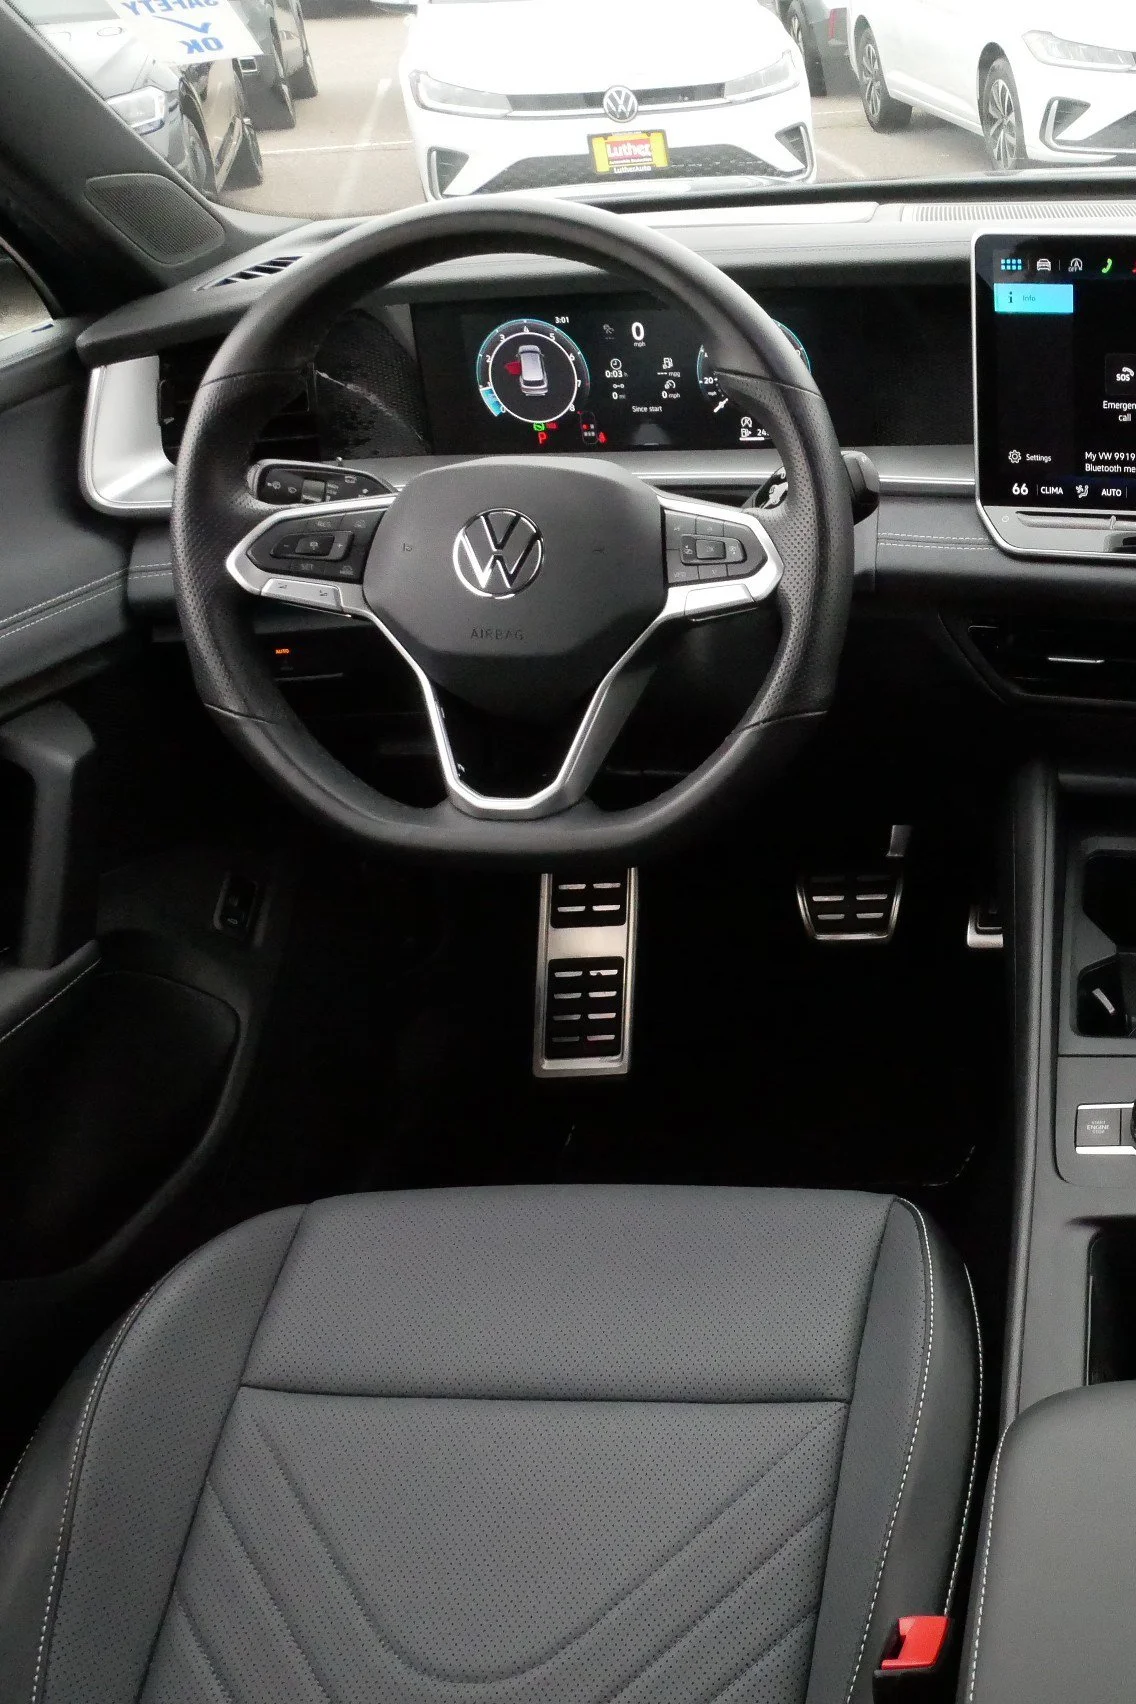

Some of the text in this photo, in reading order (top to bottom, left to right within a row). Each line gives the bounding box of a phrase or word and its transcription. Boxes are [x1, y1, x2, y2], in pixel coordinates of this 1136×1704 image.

[607, 142, 652, 158] Luther
[555, 316, 570, 324] 3:01
[631, 322, 645, 341] 0
[605, 370, 623, 378] 0:03
[703, 376, 714, 384] 20
[612, 391, 619, 400] 0
[661, 390, 668, 399] 0
[632, 405, 663, 413] Since start
[1118, 413, 1132, 422] call
[537, 431, 547, 444] P
[1025, 453, 1052, 463] Settings
[1085, 451, 1097, 462] My
[1098, 452, 1113, 460] VW
[1114, 452, 1136, 462] 9919
[1085, 463, 1122, 473] Bluetooth
[1011, 483, 1029, 496] 66
[1040, 486, 1064, 495] CLIMA
[1101, 488, 1122, 497] AUTO
[470, 628, 525, 641] AIRBAG
